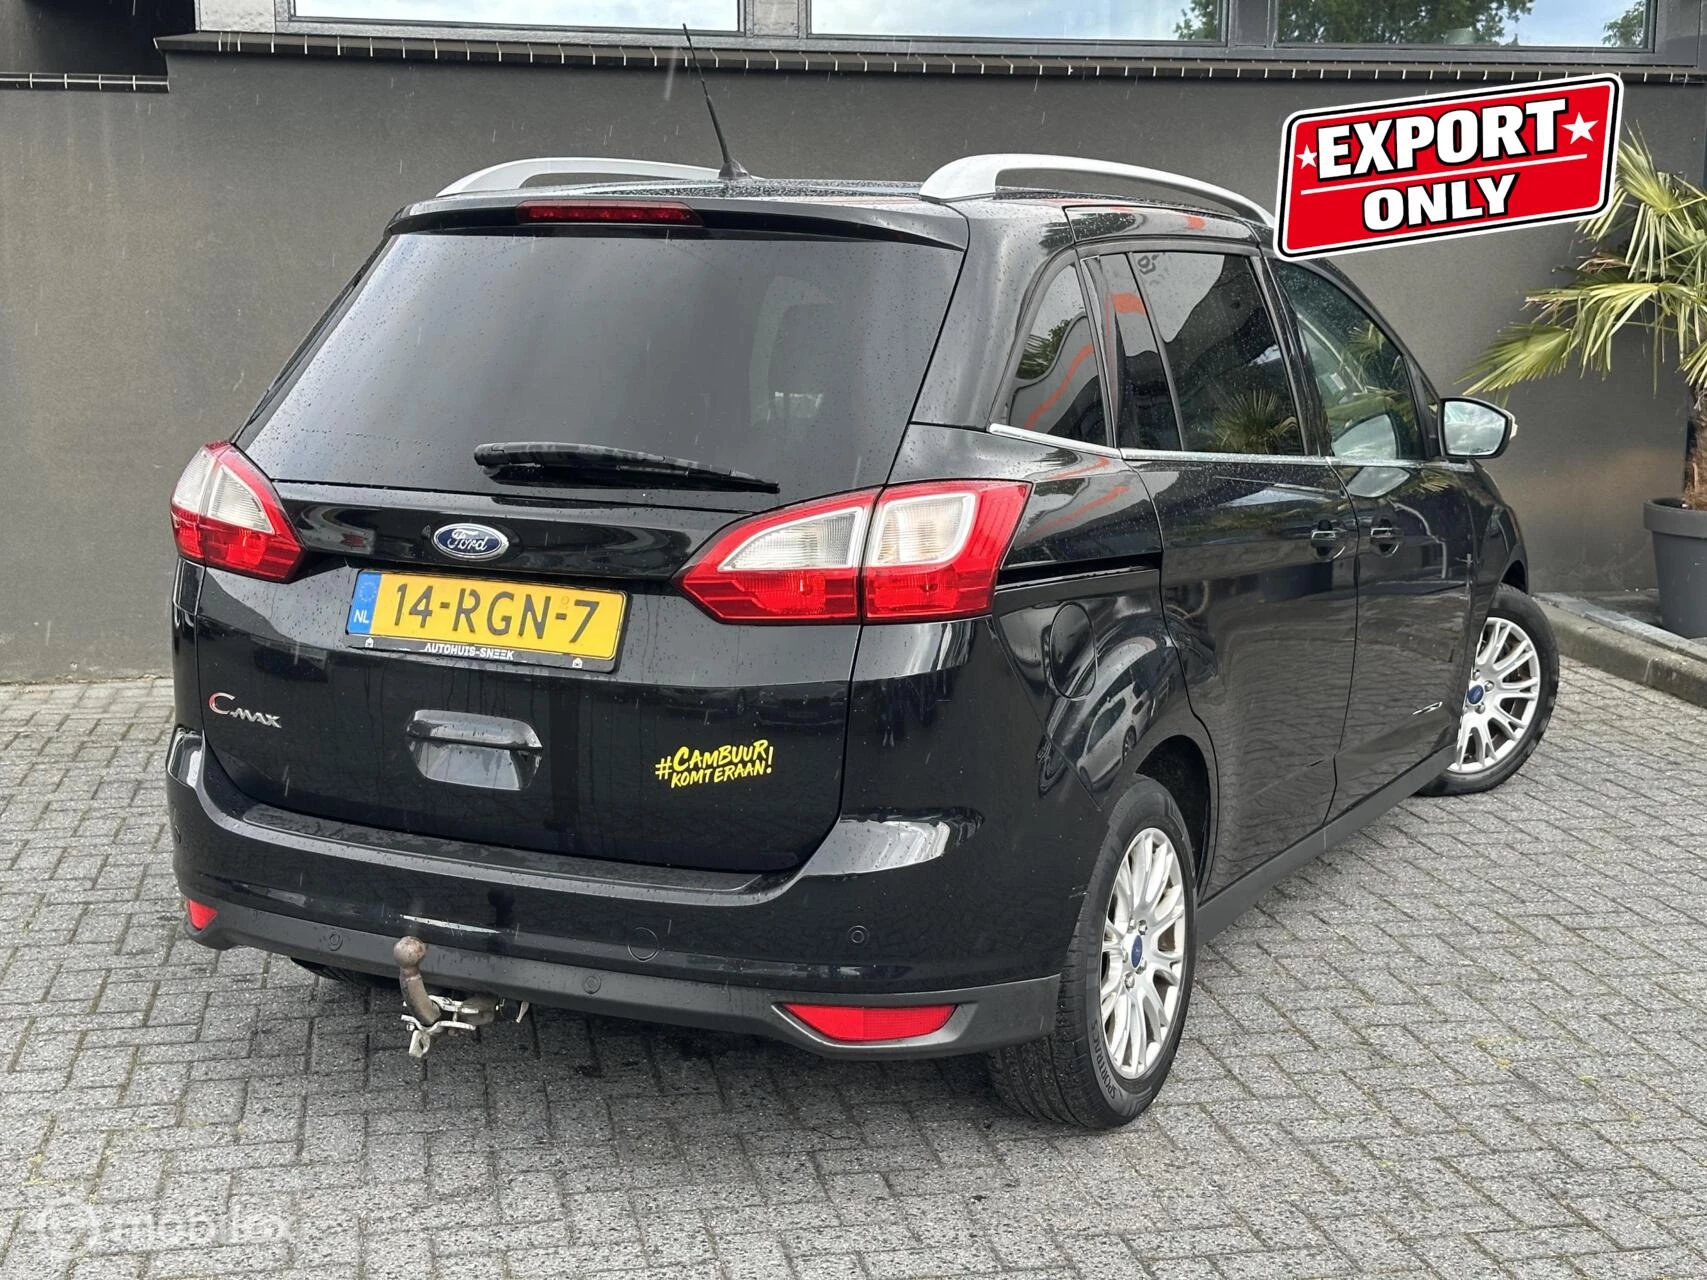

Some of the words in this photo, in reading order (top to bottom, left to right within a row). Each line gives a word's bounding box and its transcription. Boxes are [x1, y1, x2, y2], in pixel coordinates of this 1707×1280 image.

[447, 528, 489, 551] Ford
[354, 609, 370, 624] NL
[394, 583, 600, 644] 14-RGN-7
